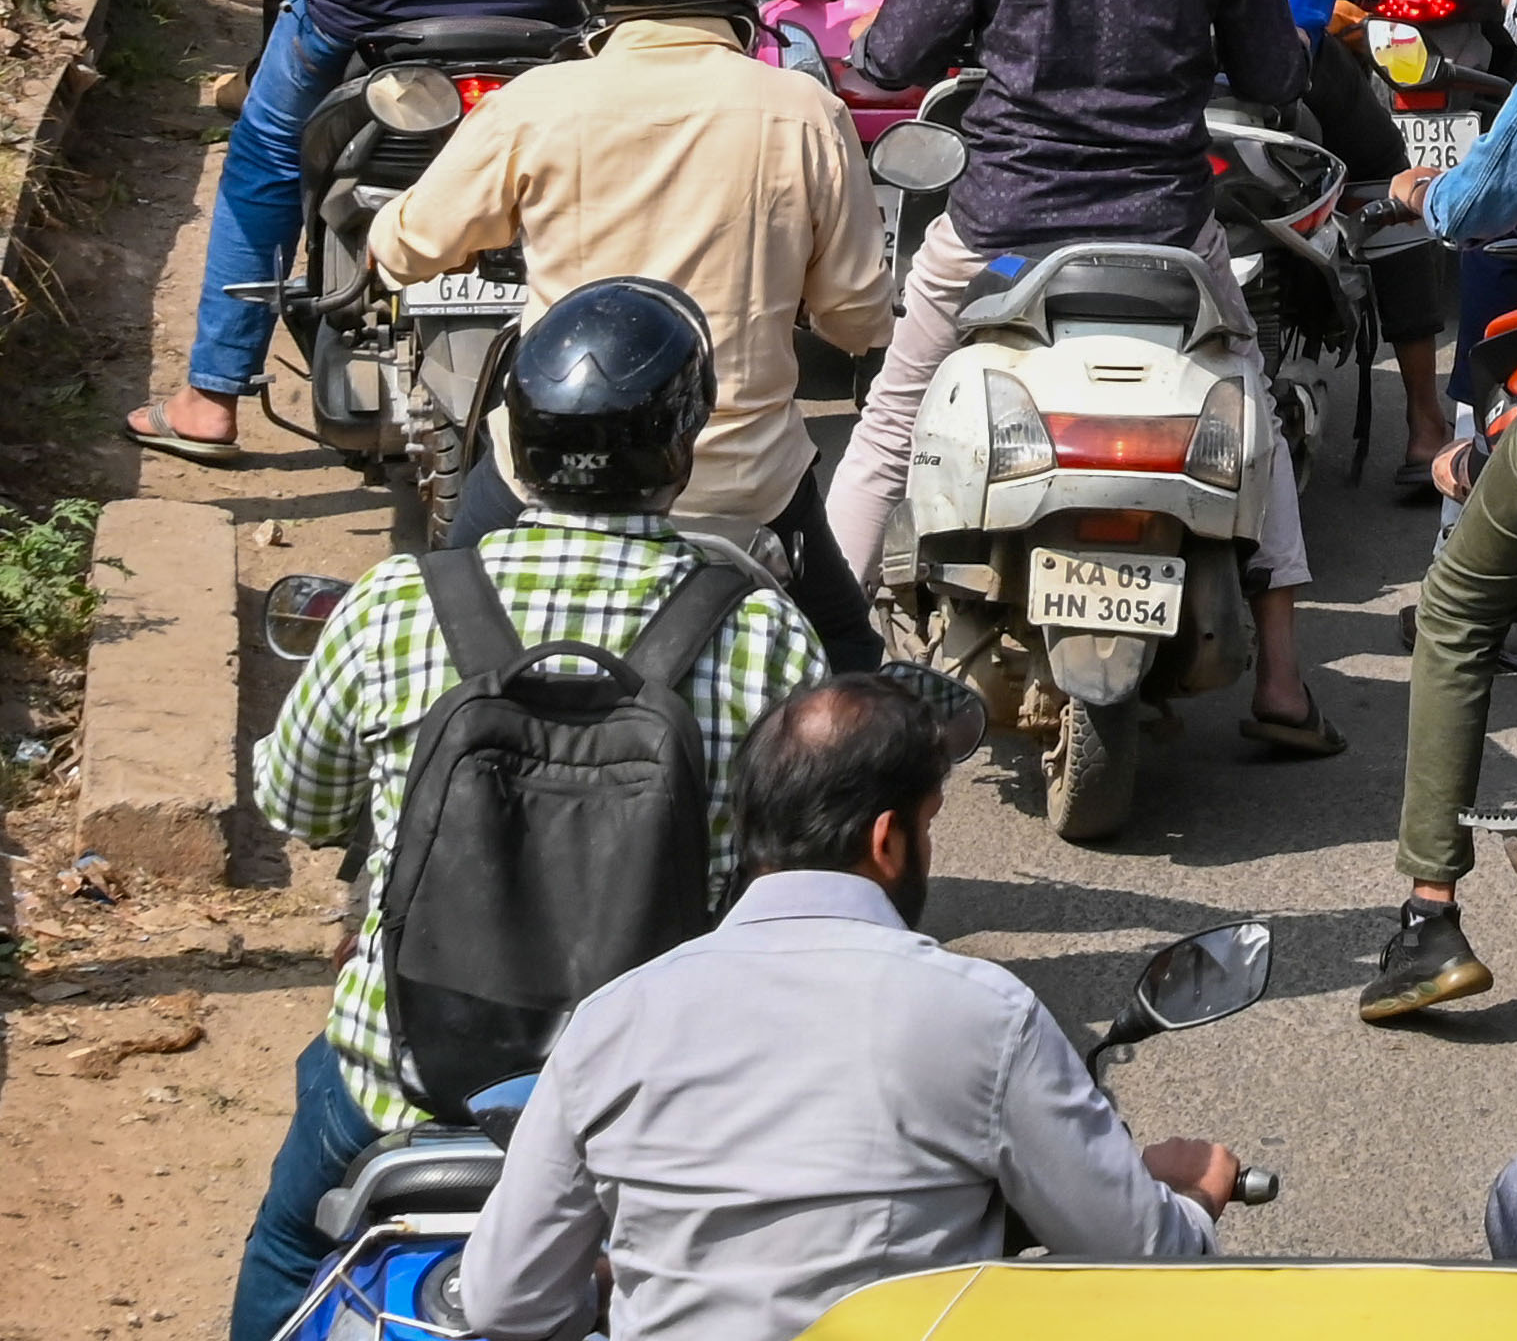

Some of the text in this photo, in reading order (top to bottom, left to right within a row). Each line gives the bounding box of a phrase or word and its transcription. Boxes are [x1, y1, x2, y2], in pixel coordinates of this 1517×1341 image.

[561, 454, 612, 470] NXT
[1064, 556, 1153, 592] KA 03
[1043, 590, 1169, 626] HN 3054
